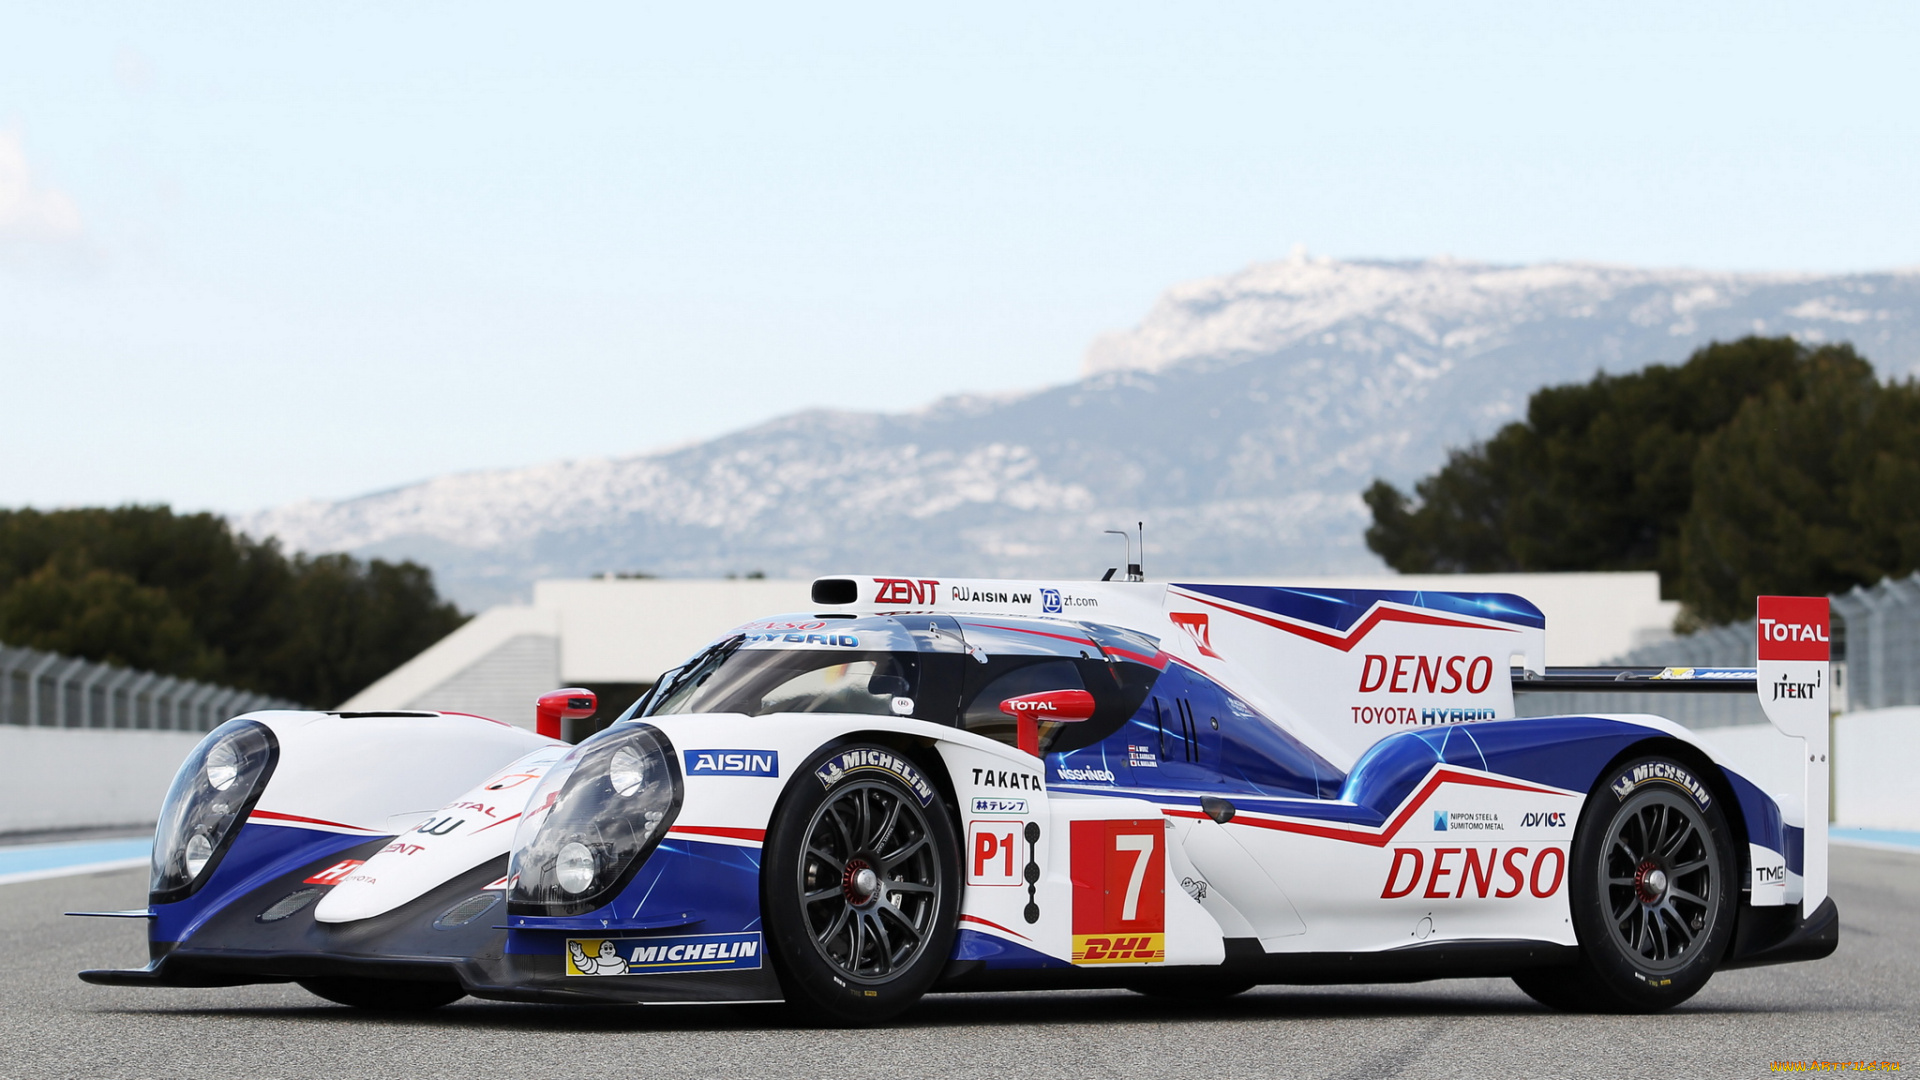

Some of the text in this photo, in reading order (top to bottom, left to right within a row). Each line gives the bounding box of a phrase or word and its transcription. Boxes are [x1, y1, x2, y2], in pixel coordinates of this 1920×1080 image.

[873, 578, 940, 605] ZENT
[972, 591, 1008, 603] AISIN
[1011, 593, 1032, 604] AW
[1063, 594, 1099, 607] zf.com
[1759, 618, 1830, 642] TOTAL
[1358, 654, 1493, 694] DENSO
[1772, 681, 1816, 702] JTEKT
[1007, 700, 1058, 711] TOTAL
[1351, 706, 1496, 725] TOYOTA HYBRID
[693, 753, 773, 773] AISIN
[841, 750, 934, 800] MICHELIN
[971, 768, 1043, 792] TAKATA
[1632, 763, 1711, 805] MICHELIN
[975, 800, 1026, 811] 林テレンプ
[1450, 812, 1498, 821] NIPPON STEEL &
[1450, 822, 1504, 831] SUMITOMO METAL
[1519, 811, 1566, 828] ADVICS
[973, 832, 1014, 877] P1
[1115, 834, 1155, 921] 7
[1380, 847, 1566, 899] DENSO
[1755, 865, 1785, 882] TMG
[629, 941, 759, 963] MICHELIN
[1083, 937, 1157, 960] DHL
